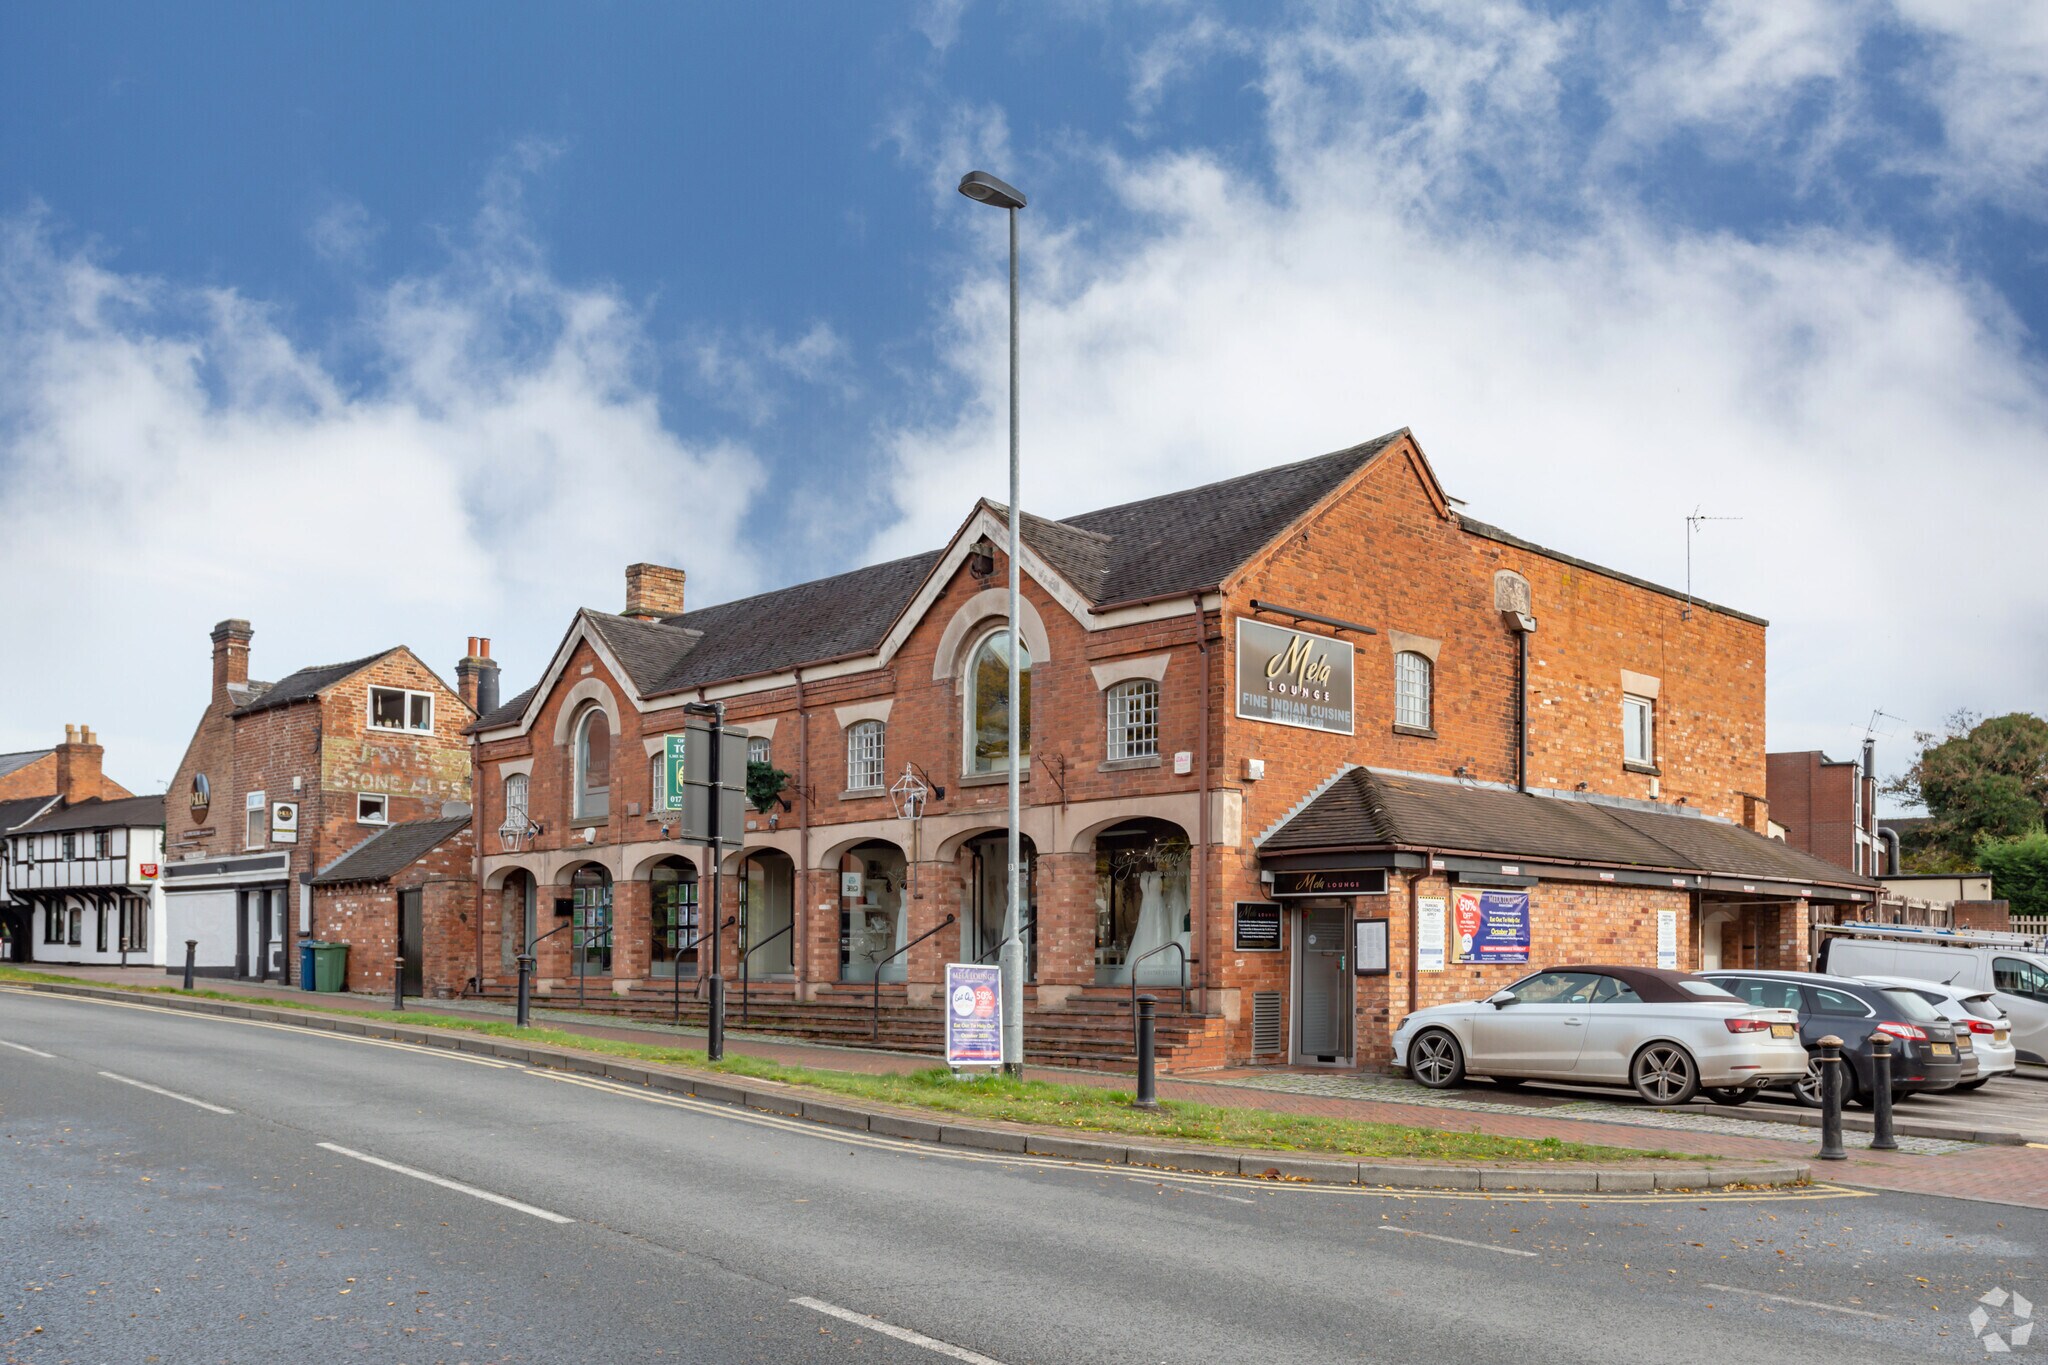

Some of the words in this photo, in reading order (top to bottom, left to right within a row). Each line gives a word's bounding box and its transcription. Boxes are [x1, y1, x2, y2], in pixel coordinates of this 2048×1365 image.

[1266, 634, 1331, 692] Mela
[1268, 681, 1330, 701] LOUNGE
[1242, 692, 1268, 709] FINE
[1271, 697, 1308, 716] INDIAN
[1310, 705, 1351, 723] CUISINE
[333, 768, 401, 792] STONE
[1296, 873, 1325, 893] Mela
[1327, 881, 1360, 889] LOUNGE
[1460, 900, 1477, 911] 50%
[953, 972, 968, 980] MELA
[970, 972, 995, 980] LOUNGE
[976, 991, 992, 1000] 50%
